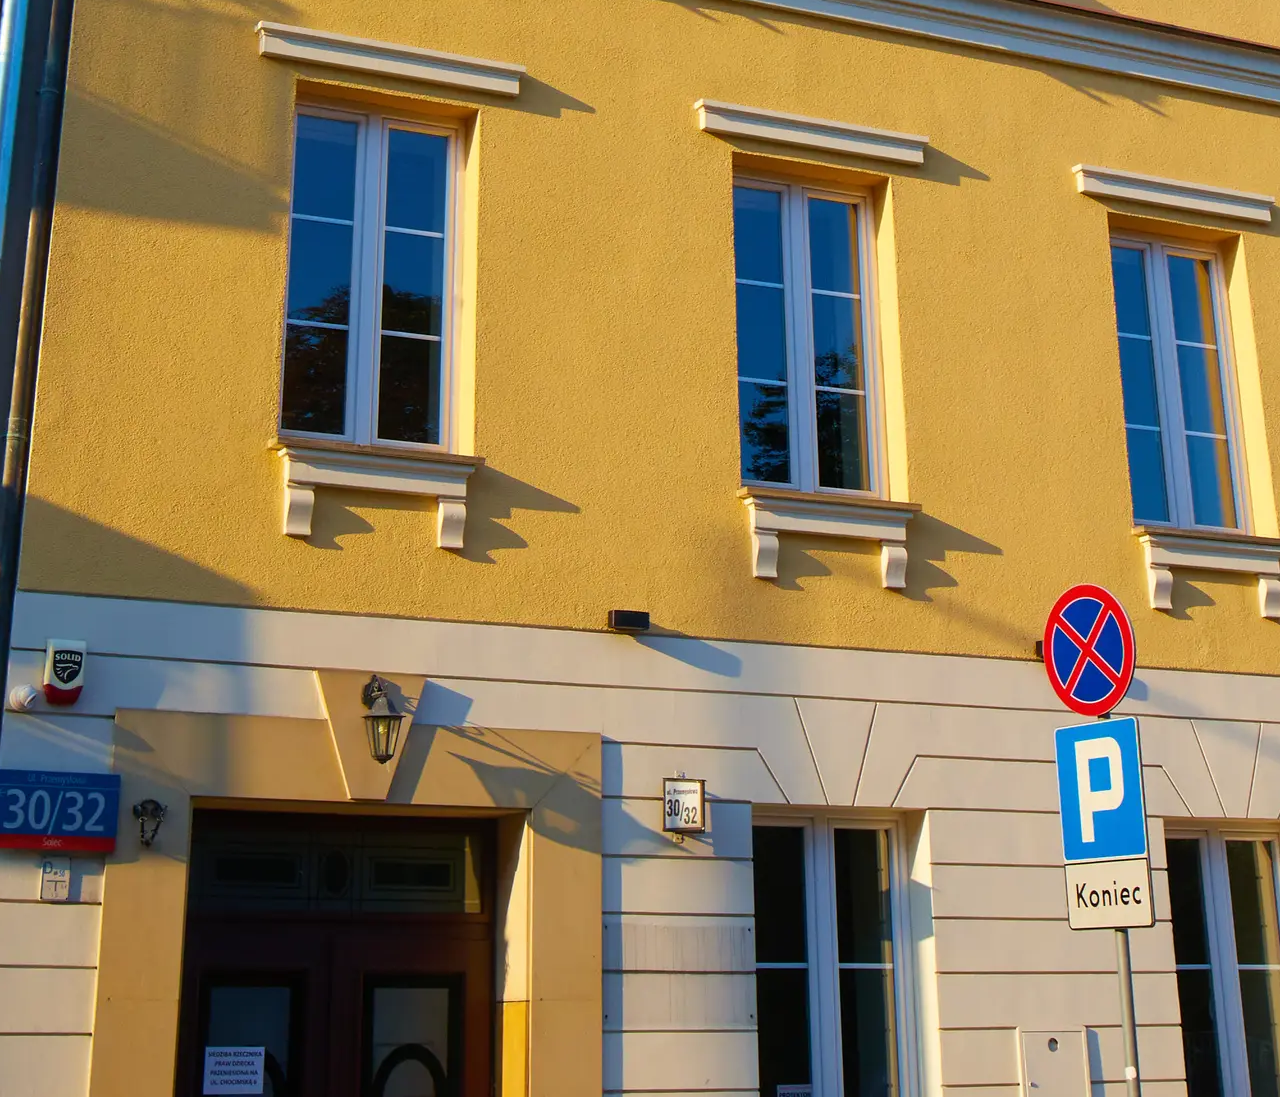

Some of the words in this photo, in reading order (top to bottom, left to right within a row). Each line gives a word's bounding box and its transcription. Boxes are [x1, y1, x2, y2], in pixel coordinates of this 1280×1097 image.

[55, 653, 81, 662] SOLID
[1074, 736, 1124, 843] P
[3, 788, 106, 835] 30/32
[666, 799, 698, 825] 30/32
[1075, 880, 1142, 908] Koniec
